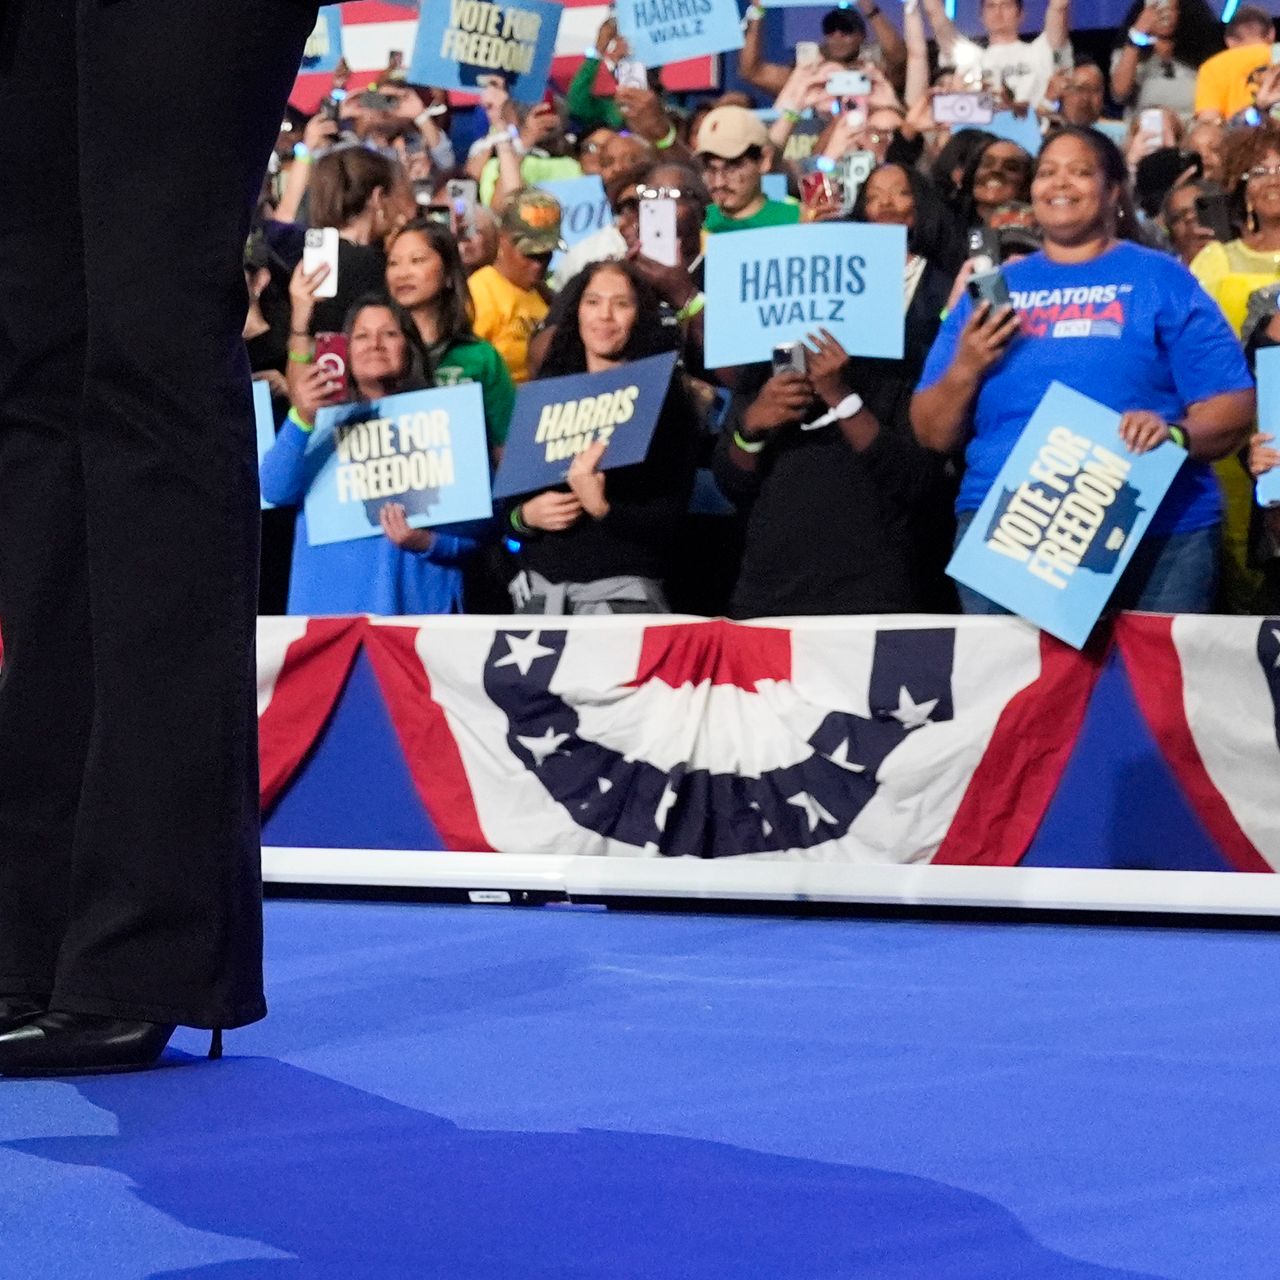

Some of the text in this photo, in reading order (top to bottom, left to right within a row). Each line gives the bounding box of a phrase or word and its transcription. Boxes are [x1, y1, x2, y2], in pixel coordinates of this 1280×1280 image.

[502, 7, 542, 42] FOR
[648, 19, 705, 44] WALZ
[440, 27, 535, 75] FREEDOM
[741, 254, 867, 303] HARRIS
[1008, 284, 1118, 309] DUCATORS
[758, 299, 845, 328] WALZ
[1014, 300, 1124, 324] AMALA
[335, 409, 451, 464] VOTE FOR
[535, 385, 640, 443] HARRIS
[336, 447, 455, 504] FREEDOM
[987, 426, 1093, 563] VOTE FOR
[1027, 444, 1132, 590] FREEDOM
